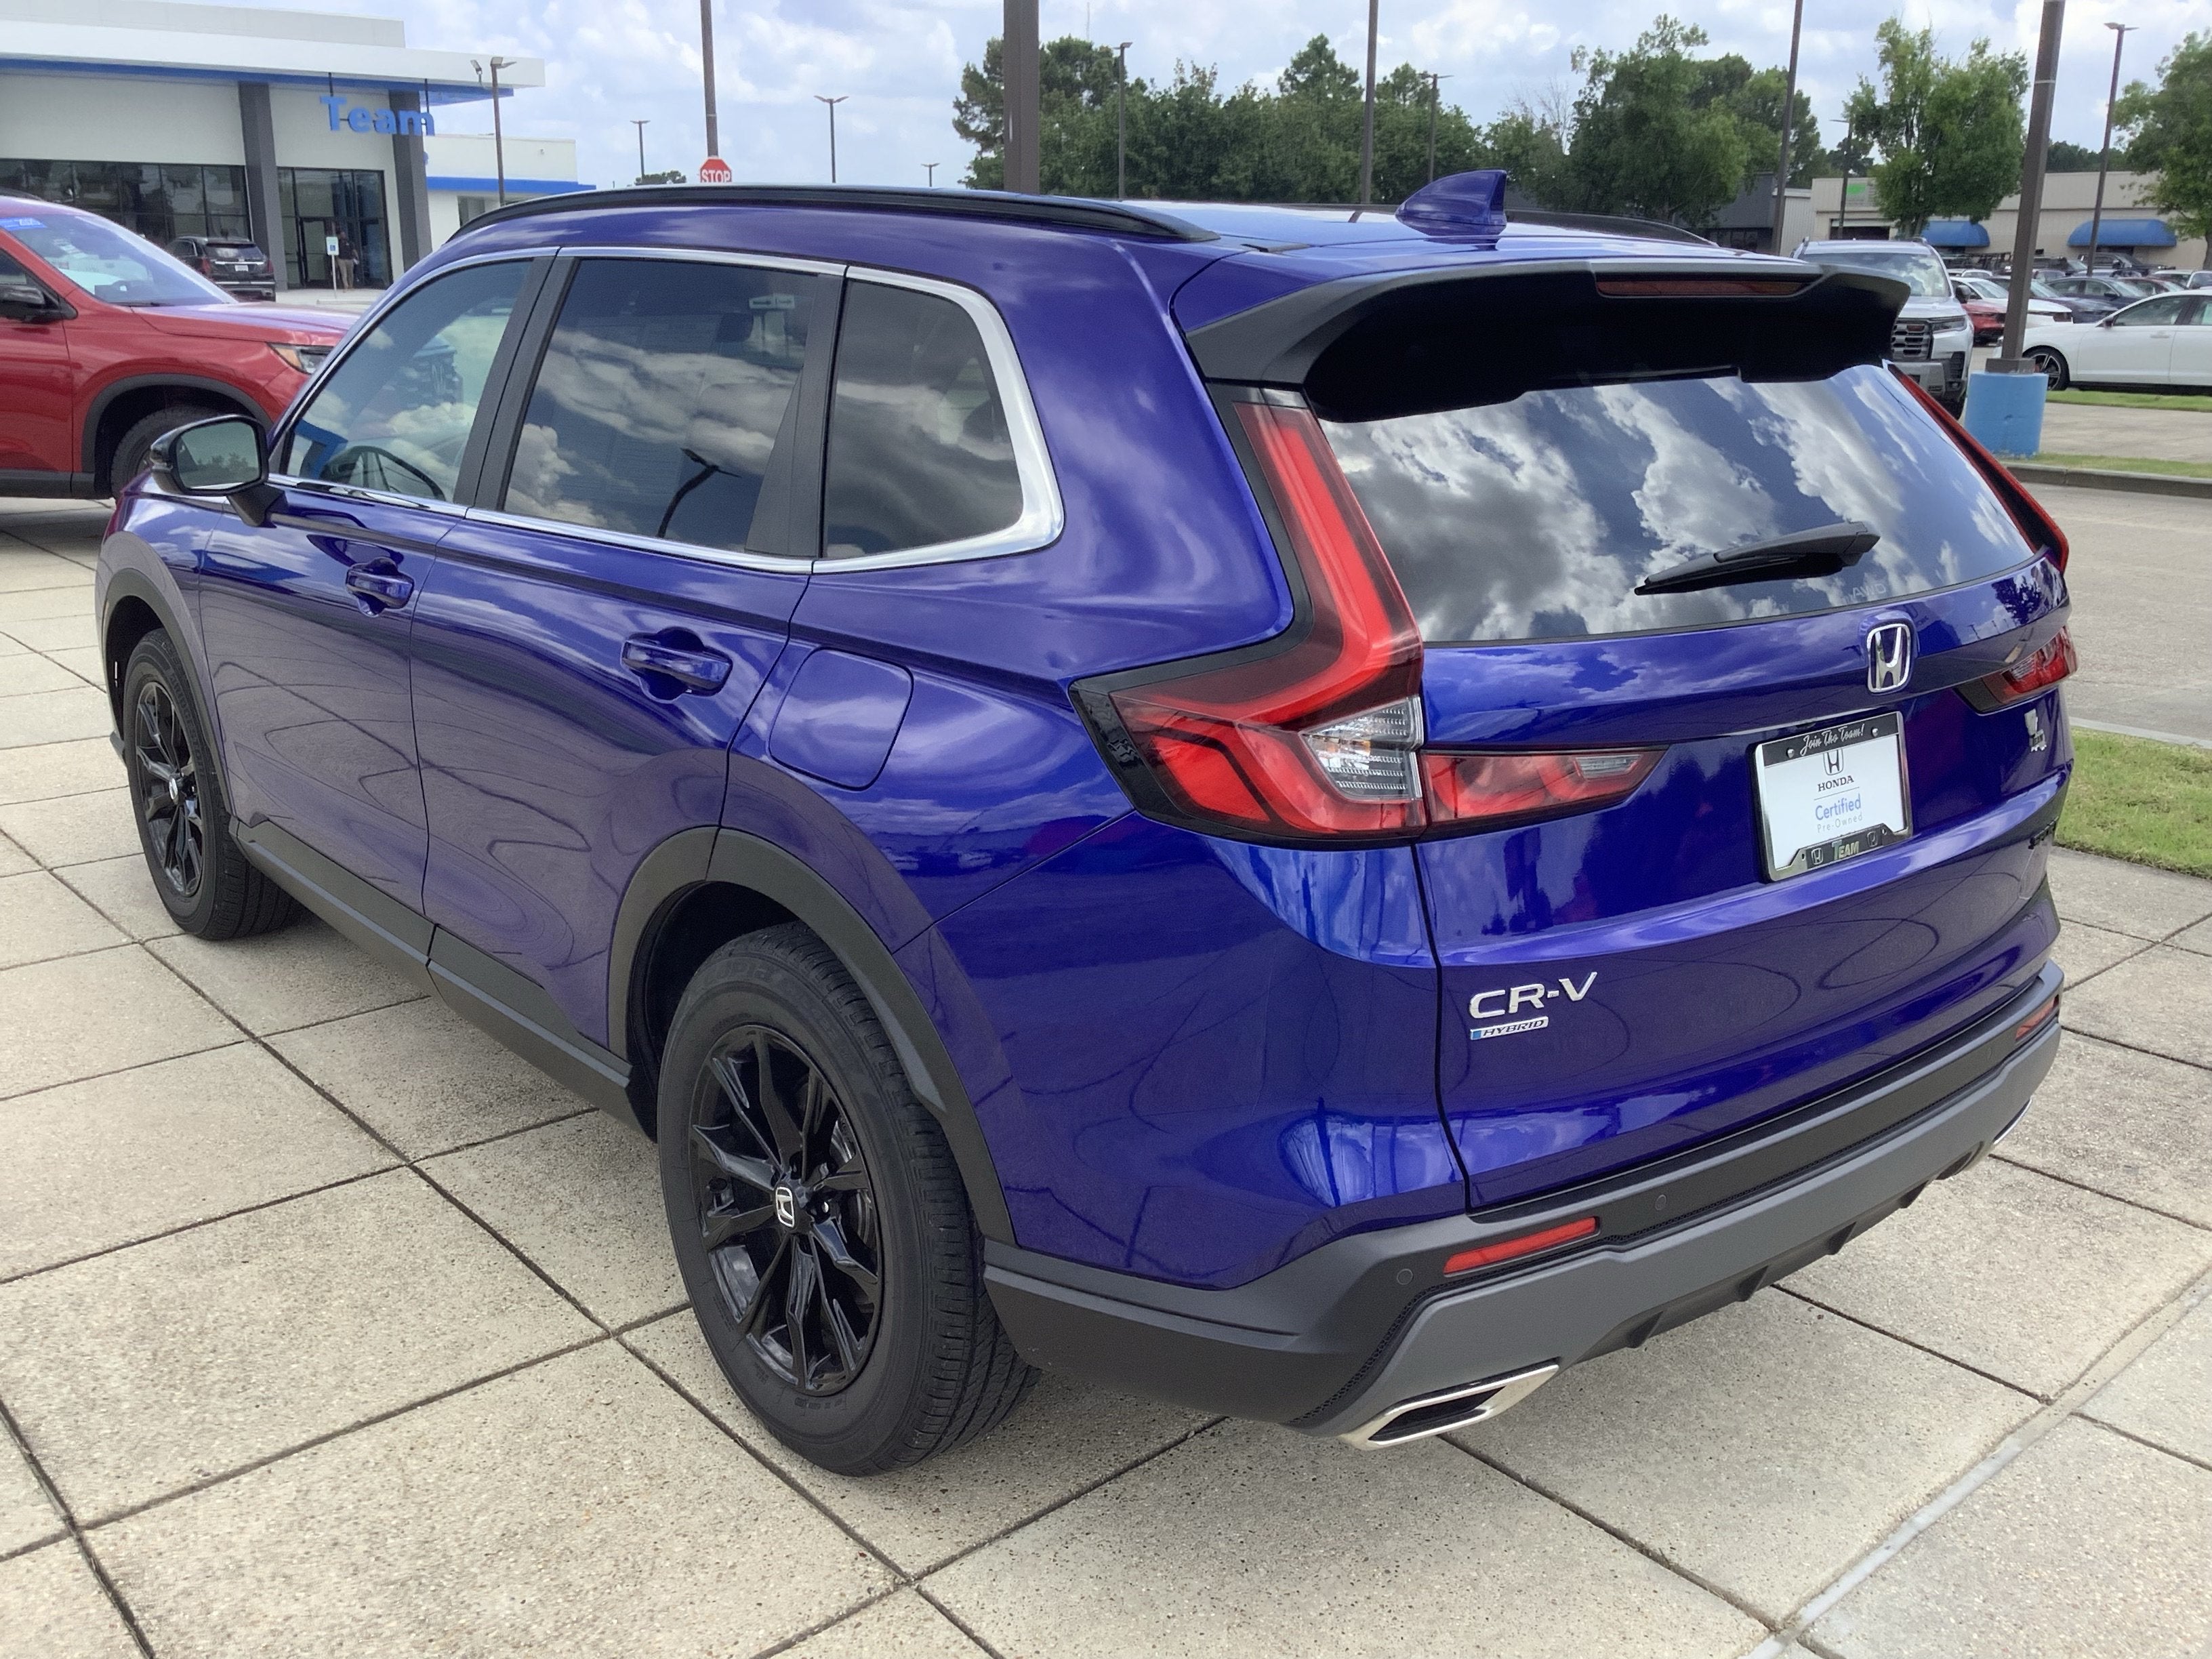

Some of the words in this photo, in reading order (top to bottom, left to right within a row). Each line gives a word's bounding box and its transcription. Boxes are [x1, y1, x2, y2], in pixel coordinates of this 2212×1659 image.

[320, 96, 435, 136] Team
[701, 169, 731, 183] STOP
[1852, 583, 1887, 598] AWD
[1800, 735, 1822, 756] Join
[1822, 730, 1839, 745] The
[1838, 723, 1865, 742] Team!
[1817, 775, 1854, 792] HONDA
[1815, 793, 1862, 821] Certified
[1817, 812, 1863, 834] Pre-Owned
[1832, 840, 1860, 860] TEAM
[1469, 971, 1598, 1019] CR-V
[1483, 1019, 1545, 1038] HYBRID
